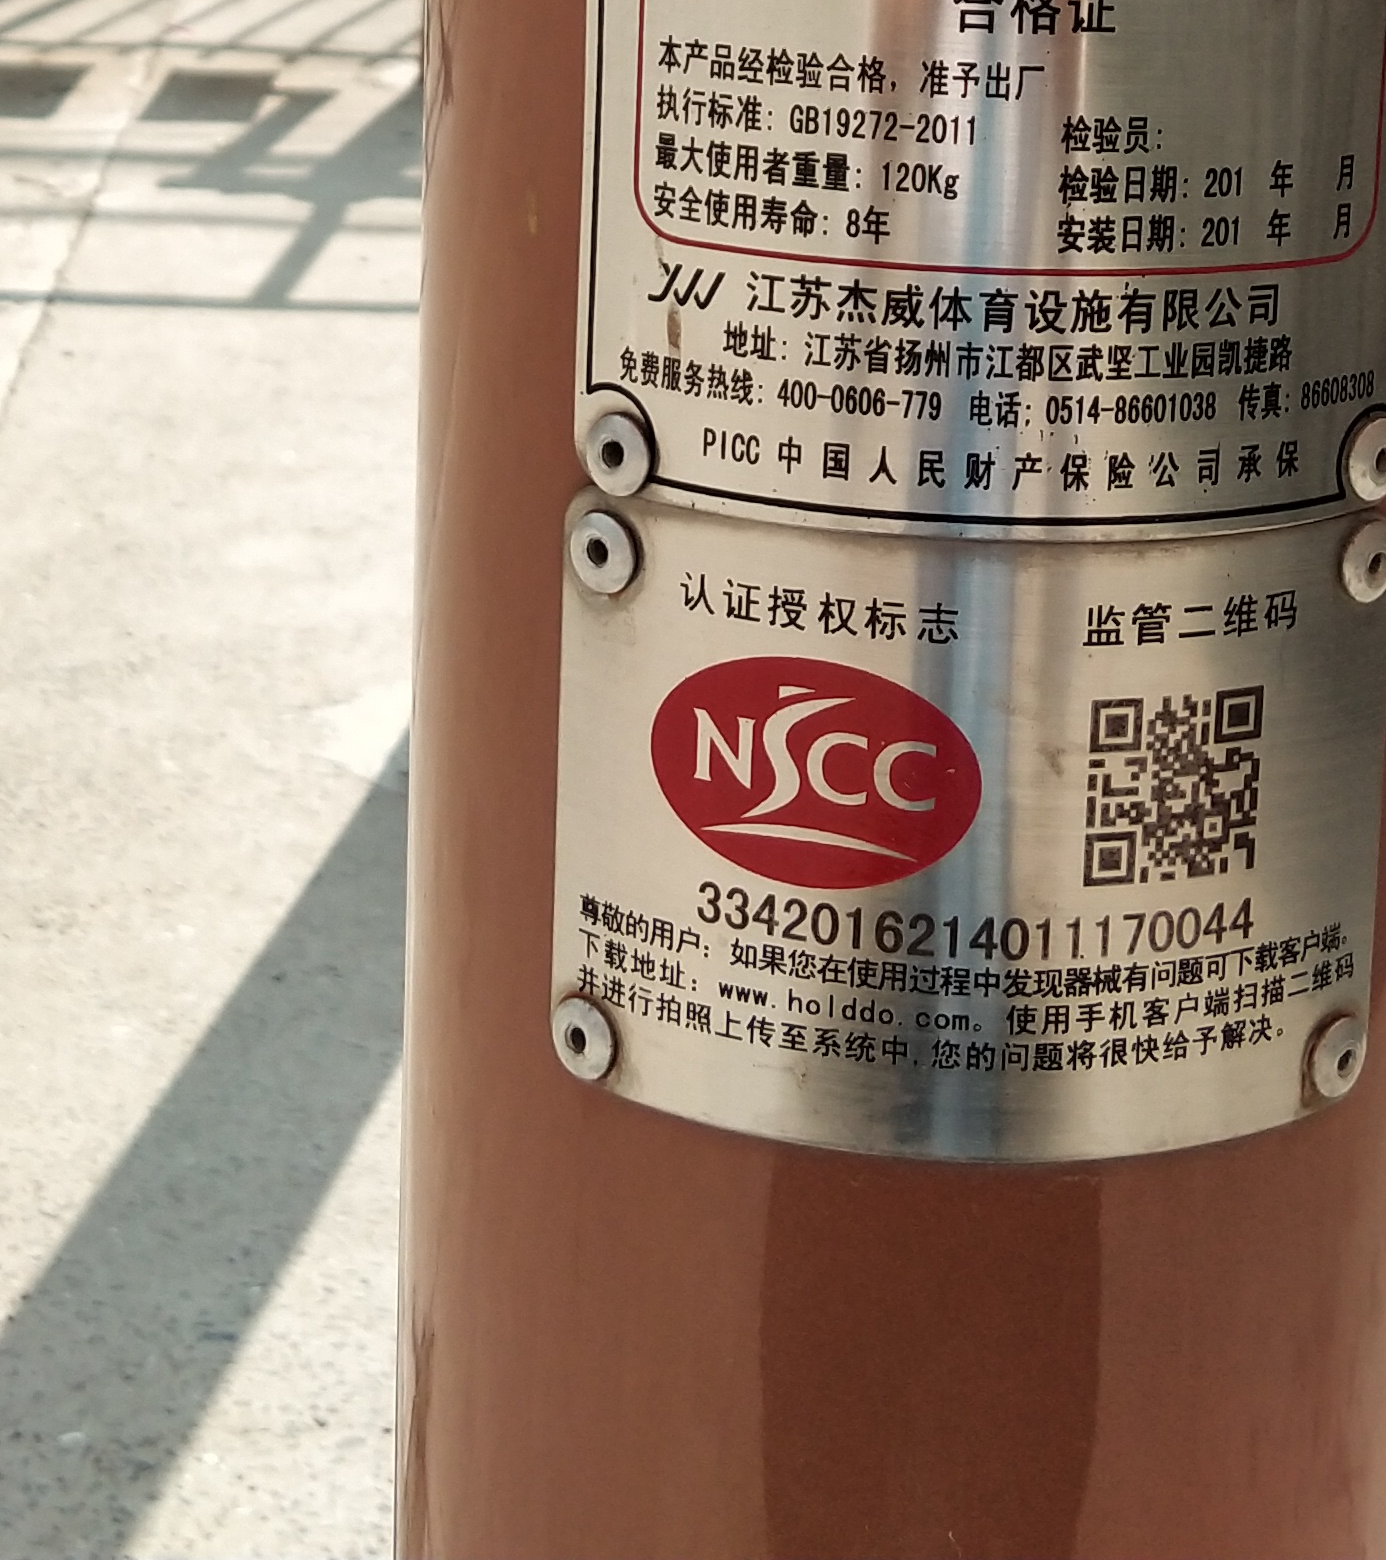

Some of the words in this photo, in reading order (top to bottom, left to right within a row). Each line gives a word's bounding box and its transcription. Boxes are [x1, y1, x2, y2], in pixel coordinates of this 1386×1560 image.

[657, 34, 1045, 102] 本产品经检验合格，准予出厂
[1060, 115, 1164, 155] 检验员：
[1268, 159, 1295, 198] 年
[1335, 153, 1356, 192] 月
[653, 180, 891, 245] 安全使用寿命：8年
[1265, 207, 1292, 247] 年
[1332, 202, 1353, 240] 月
[745, 270, 1280, 334] 江苏杰威体育设施有限公司
[702, 427, 761, 466] PICC
[679, 571, 960, 645] 认证授权标志
[1082, 590, 1299, 648] 监管二维码
[692, 686, 938, 818] NSCC
[696, 880, 1255, 961] 3342016214011170044
